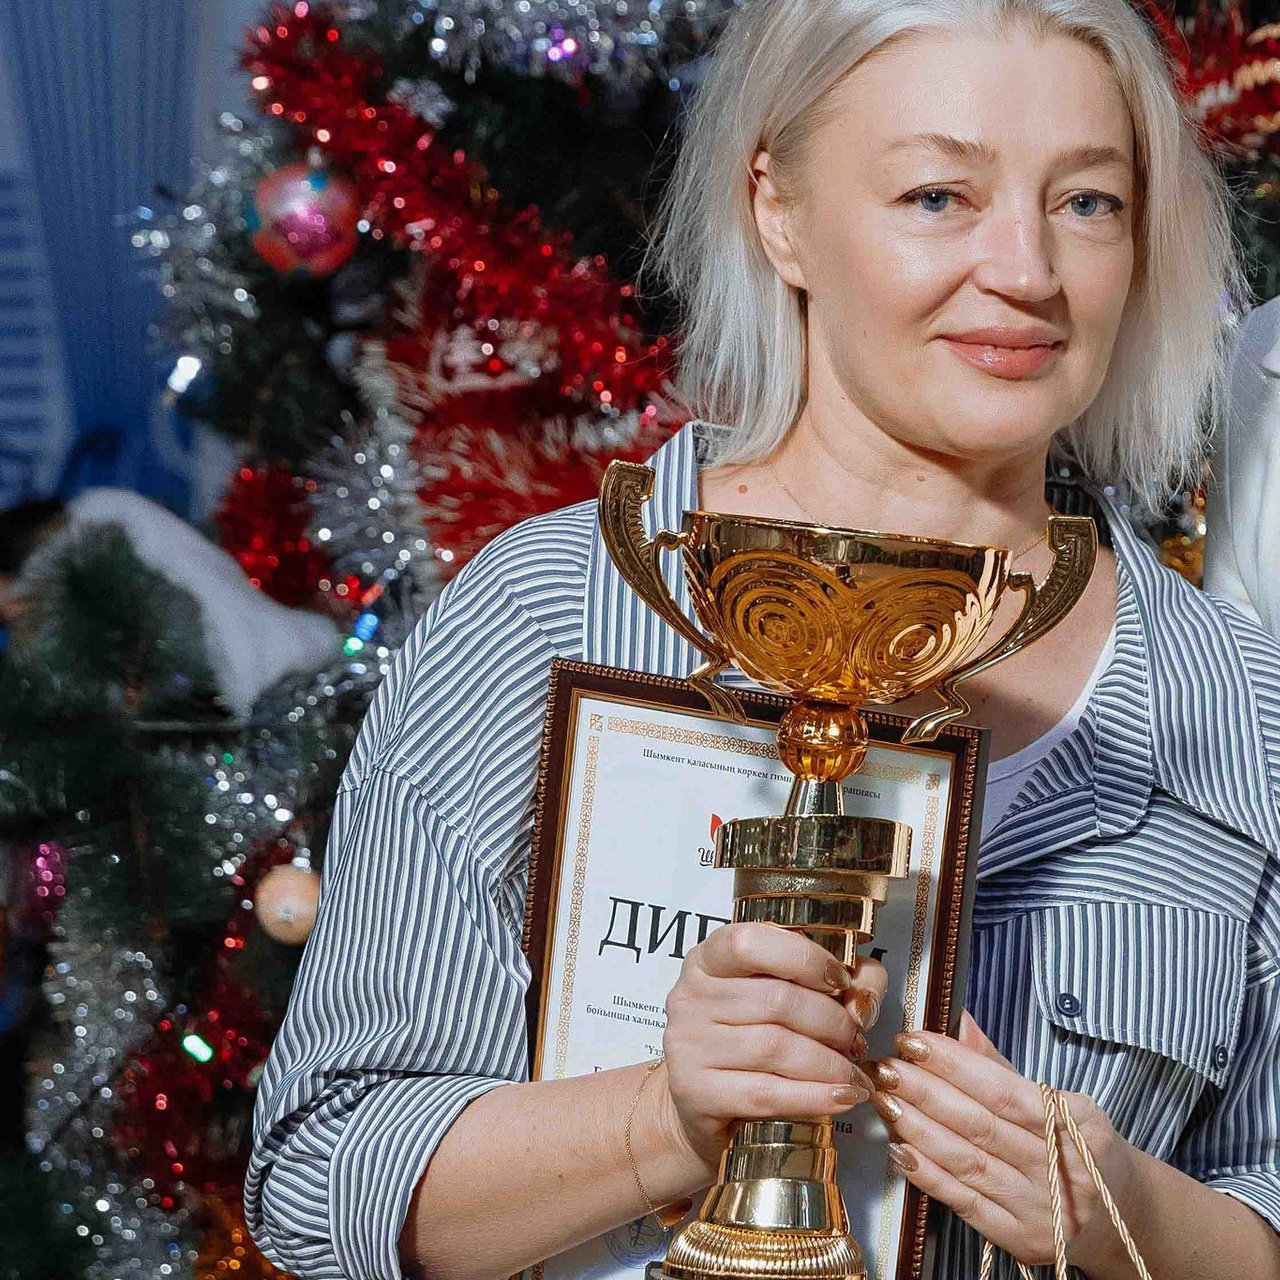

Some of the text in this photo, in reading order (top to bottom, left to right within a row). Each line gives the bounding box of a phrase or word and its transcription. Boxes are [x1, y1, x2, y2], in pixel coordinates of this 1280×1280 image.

[643, 748, 686, 764] Шымкент
[842, 786, 881, 800] рациясы
[612, 995, 660, 1013] Шымкент
[586, 1004, 630, 1022] бойынша
